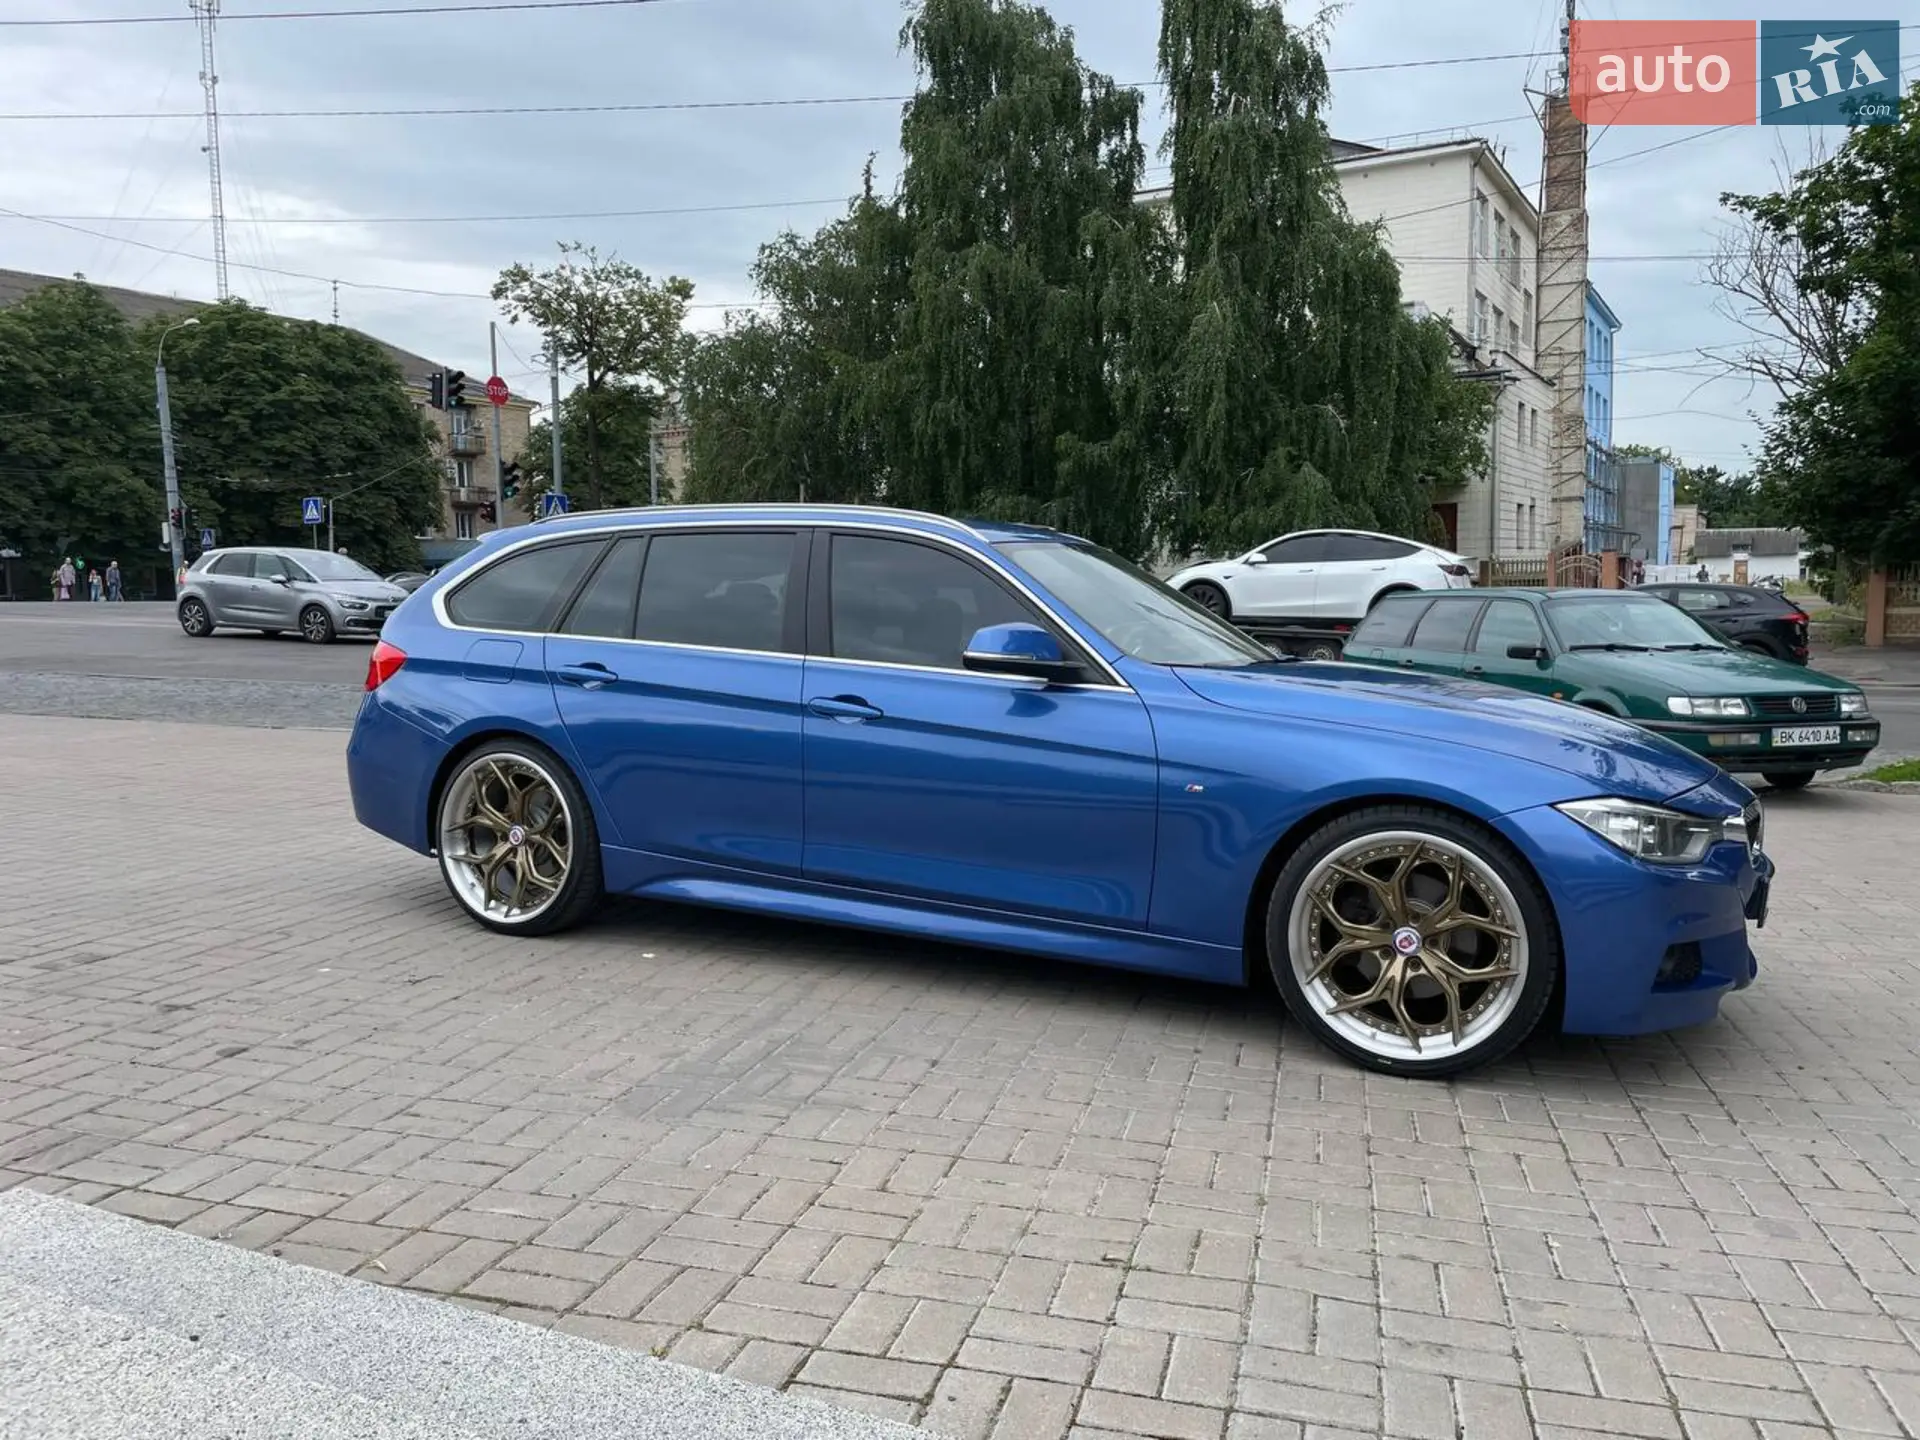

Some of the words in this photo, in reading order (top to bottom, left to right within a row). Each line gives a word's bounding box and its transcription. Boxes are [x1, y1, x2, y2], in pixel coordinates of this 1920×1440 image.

[487, 384, 508, 397] STOP
[1780, 731, 1795, 744] BK
[1798, 730, 1822, 743] 6410
[1824, 729, 1838, 742] AA
